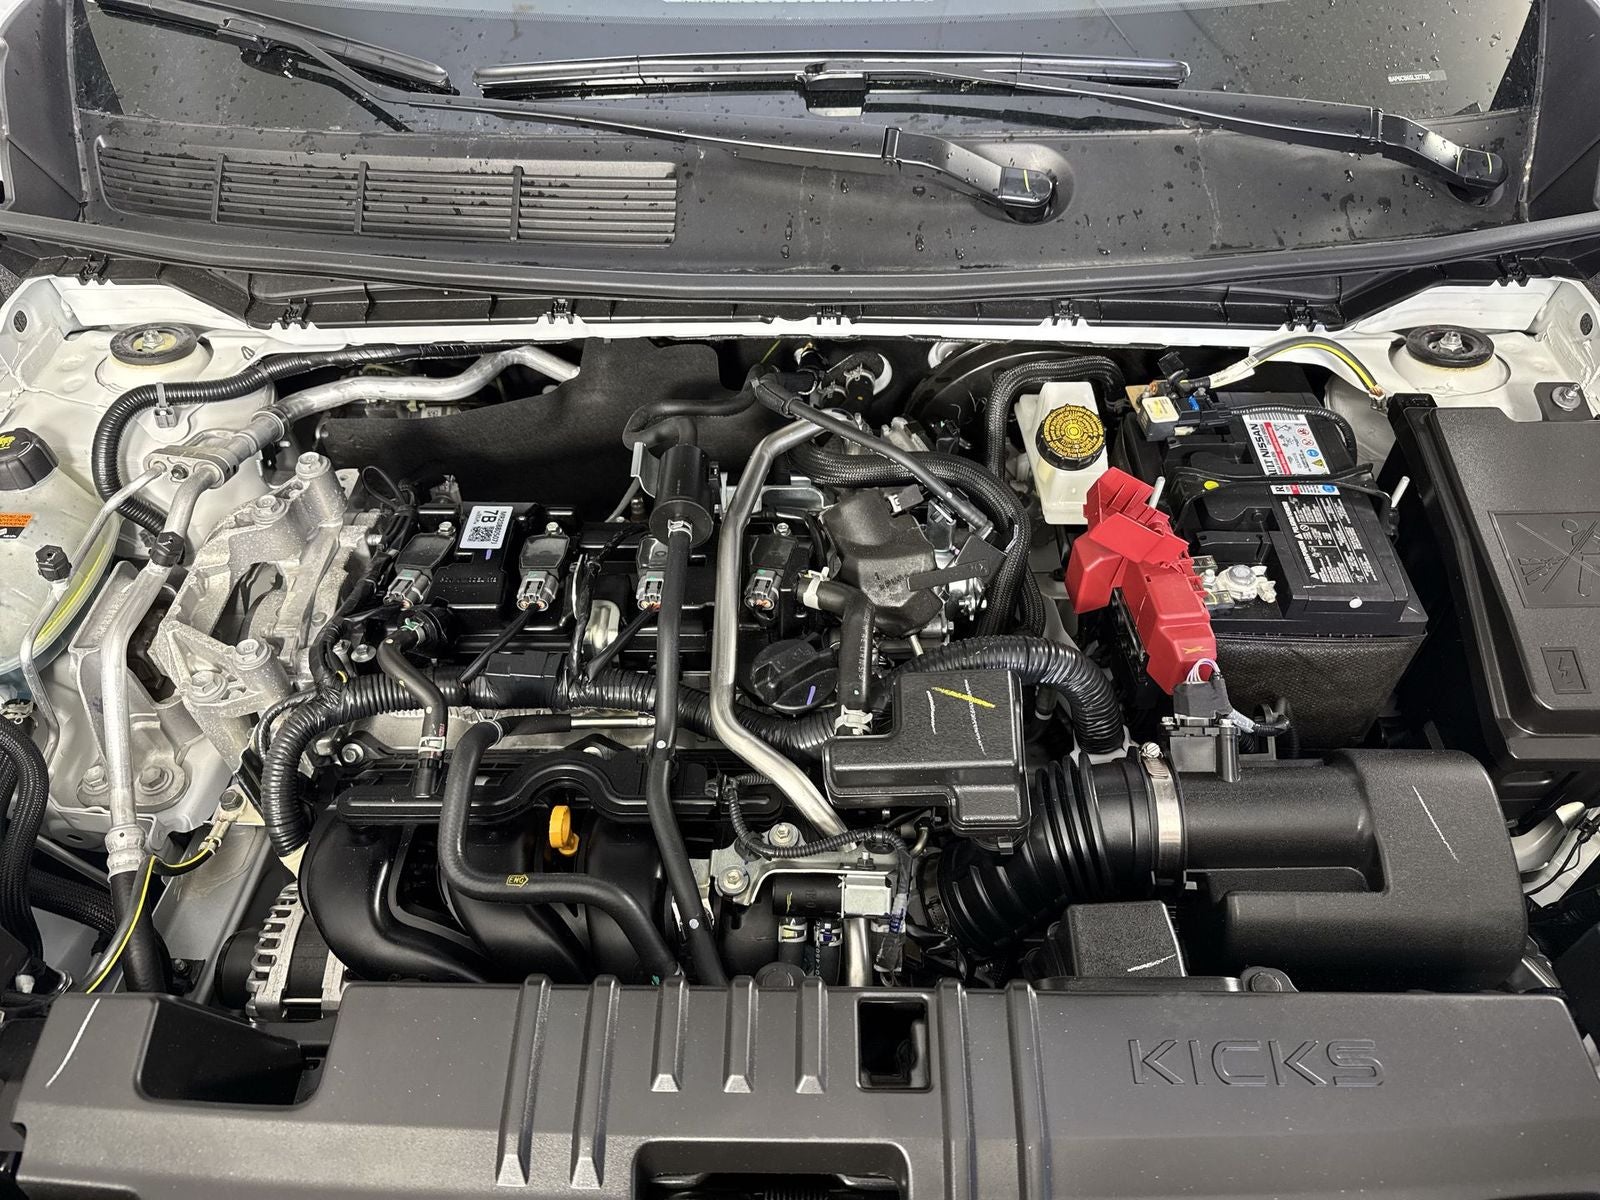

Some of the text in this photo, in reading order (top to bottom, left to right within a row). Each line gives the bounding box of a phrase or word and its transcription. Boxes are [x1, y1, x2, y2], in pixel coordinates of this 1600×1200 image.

[1250, 423, 1272, 458] NISSAN
[481, 510, 499, 523] 7B
[1128, 1039, 1385, 1087] KICKS
